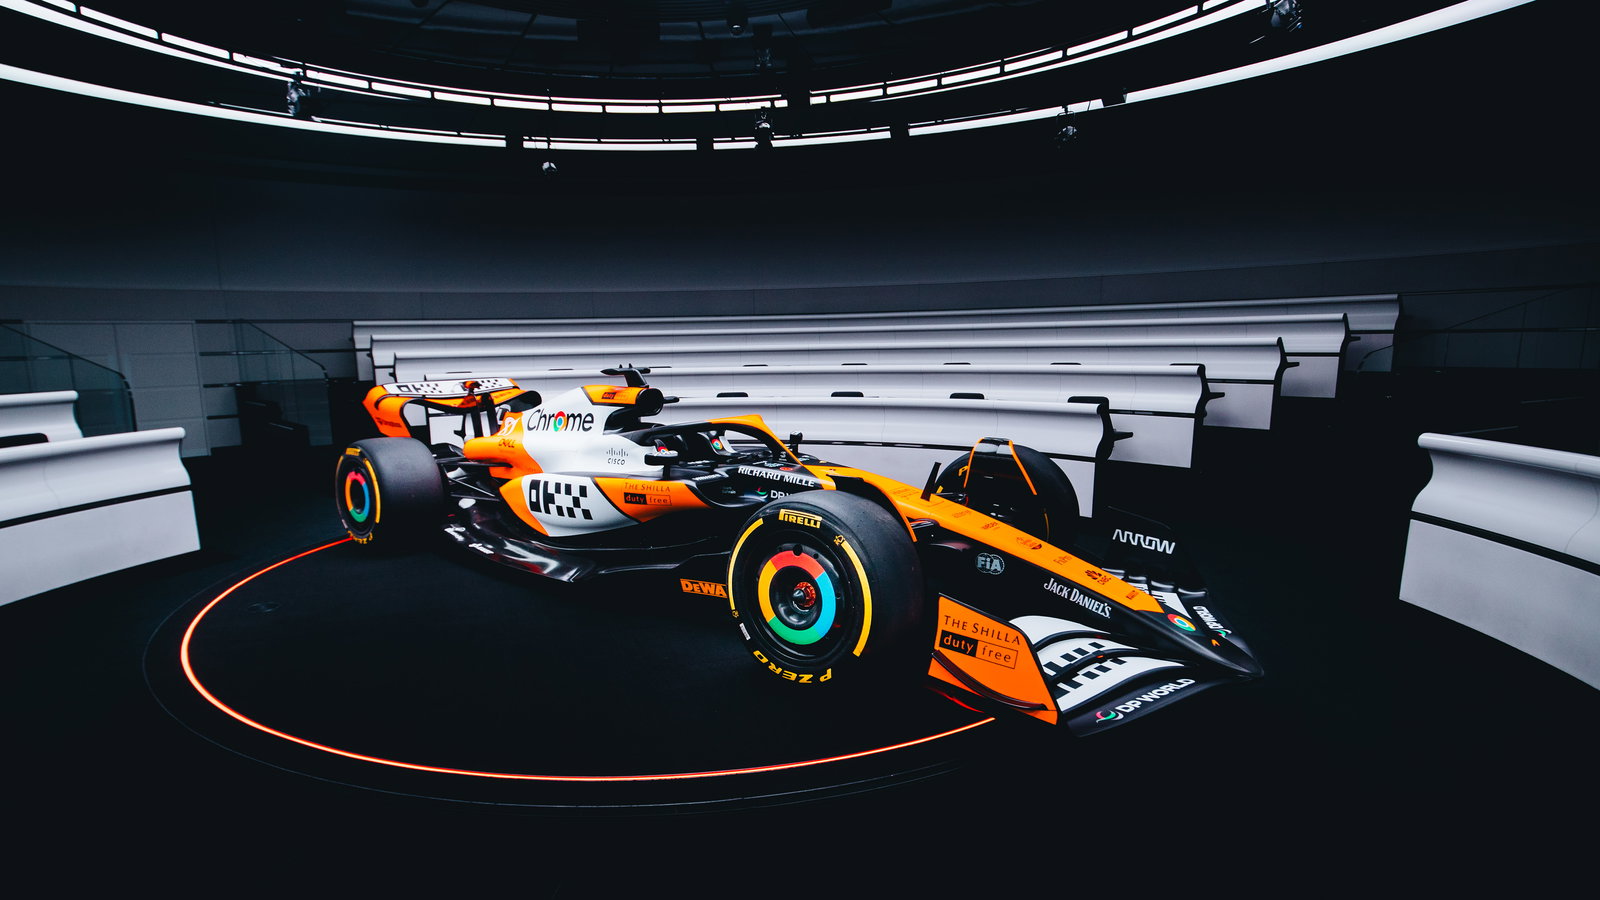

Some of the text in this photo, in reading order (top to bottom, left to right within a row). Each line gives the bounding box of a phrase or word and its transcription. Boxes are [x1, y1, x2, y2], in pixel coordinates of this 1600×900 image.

[527, 408, 594, 432] Chrome
[607, 457, 626, 466] CISCO
[624, 482, 669, 493] THE SHILLA
[737, 466, 780, 481] RICHARD
[783, 474, 815, 487] MILLE
[625, 494, 644, 504] duty
[778, 509, 823, 529] PIRELLI
[1112, 528, 1175, 555] ARROW
[1043, 577, 1070, 600] JACK
[943, 615, 1021, 645] THE SHILLA
[943, 635, 1011, 662] duty free
[753, 650, 833, 683] P ZERO
[1115, 678, 1195, 713] DP WORLD
